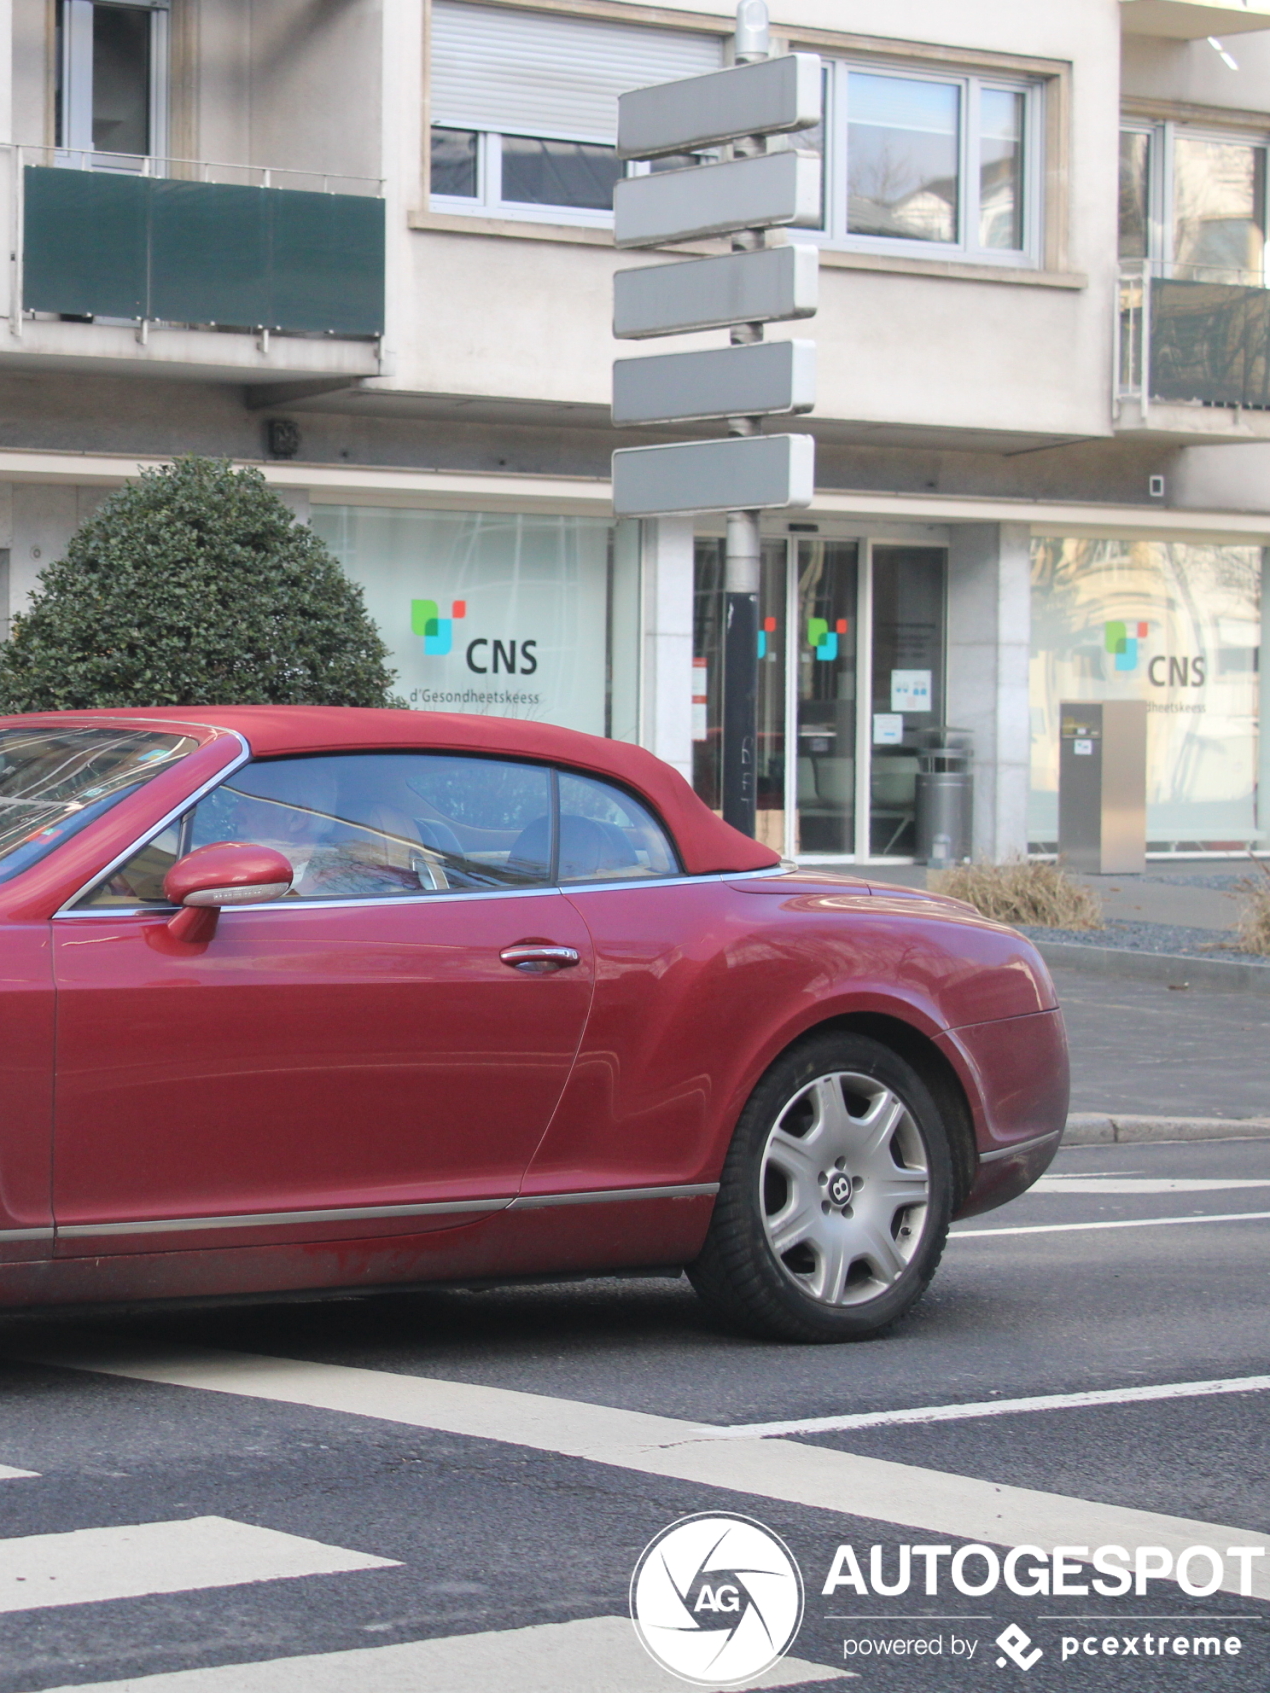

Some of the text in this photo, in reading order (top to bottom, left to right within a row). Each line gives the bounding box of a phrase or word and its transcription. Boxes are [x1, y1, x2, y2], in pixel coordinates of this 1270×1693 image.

[466, 638, 537, 675] CNS
[1148, 656, 1205, 687] CNS
[410, 689, 539, 704] d'Gesondheetskeess
